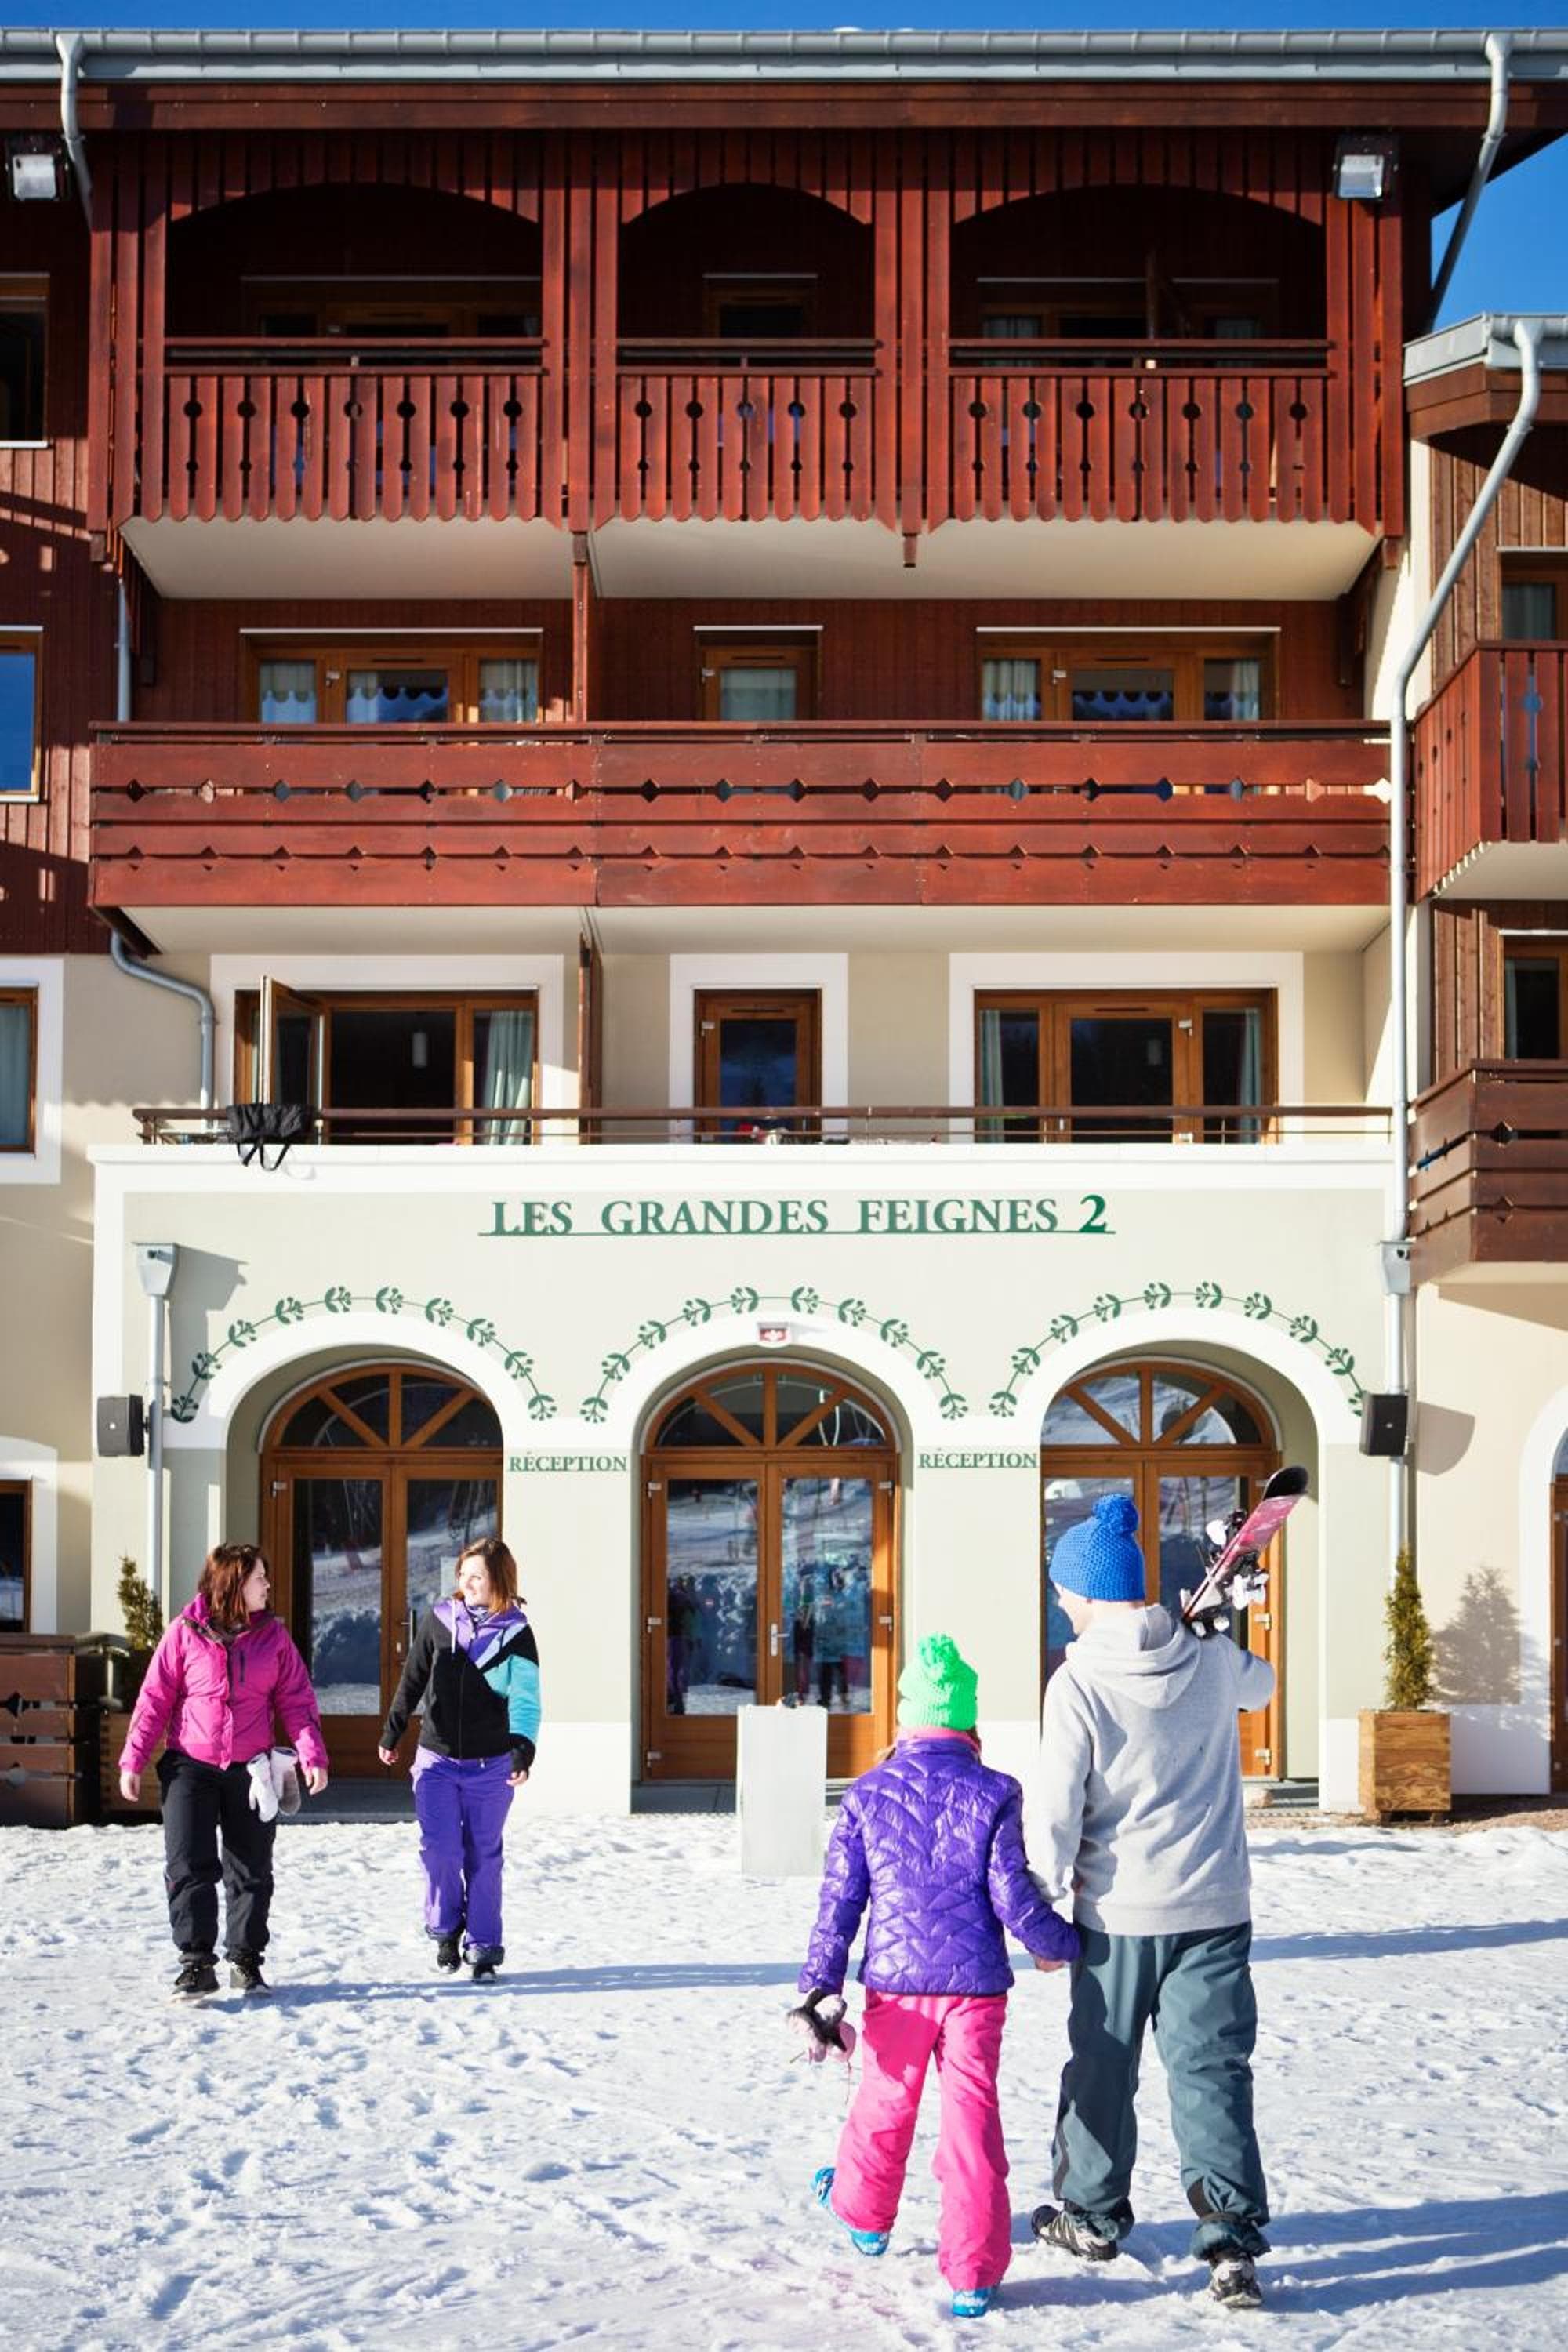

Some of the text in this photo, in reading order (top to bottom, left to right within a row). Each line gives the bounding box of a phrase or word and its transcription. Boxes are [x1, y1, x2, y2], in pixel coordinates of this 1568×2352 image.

[492, 1194, 1108, 1236] LES GRANDES FEIGNES 2
[510, 1450, 627, 1472] RÉCEPTION
[918, 1447, 1037, 1468] RÉCEPTION
